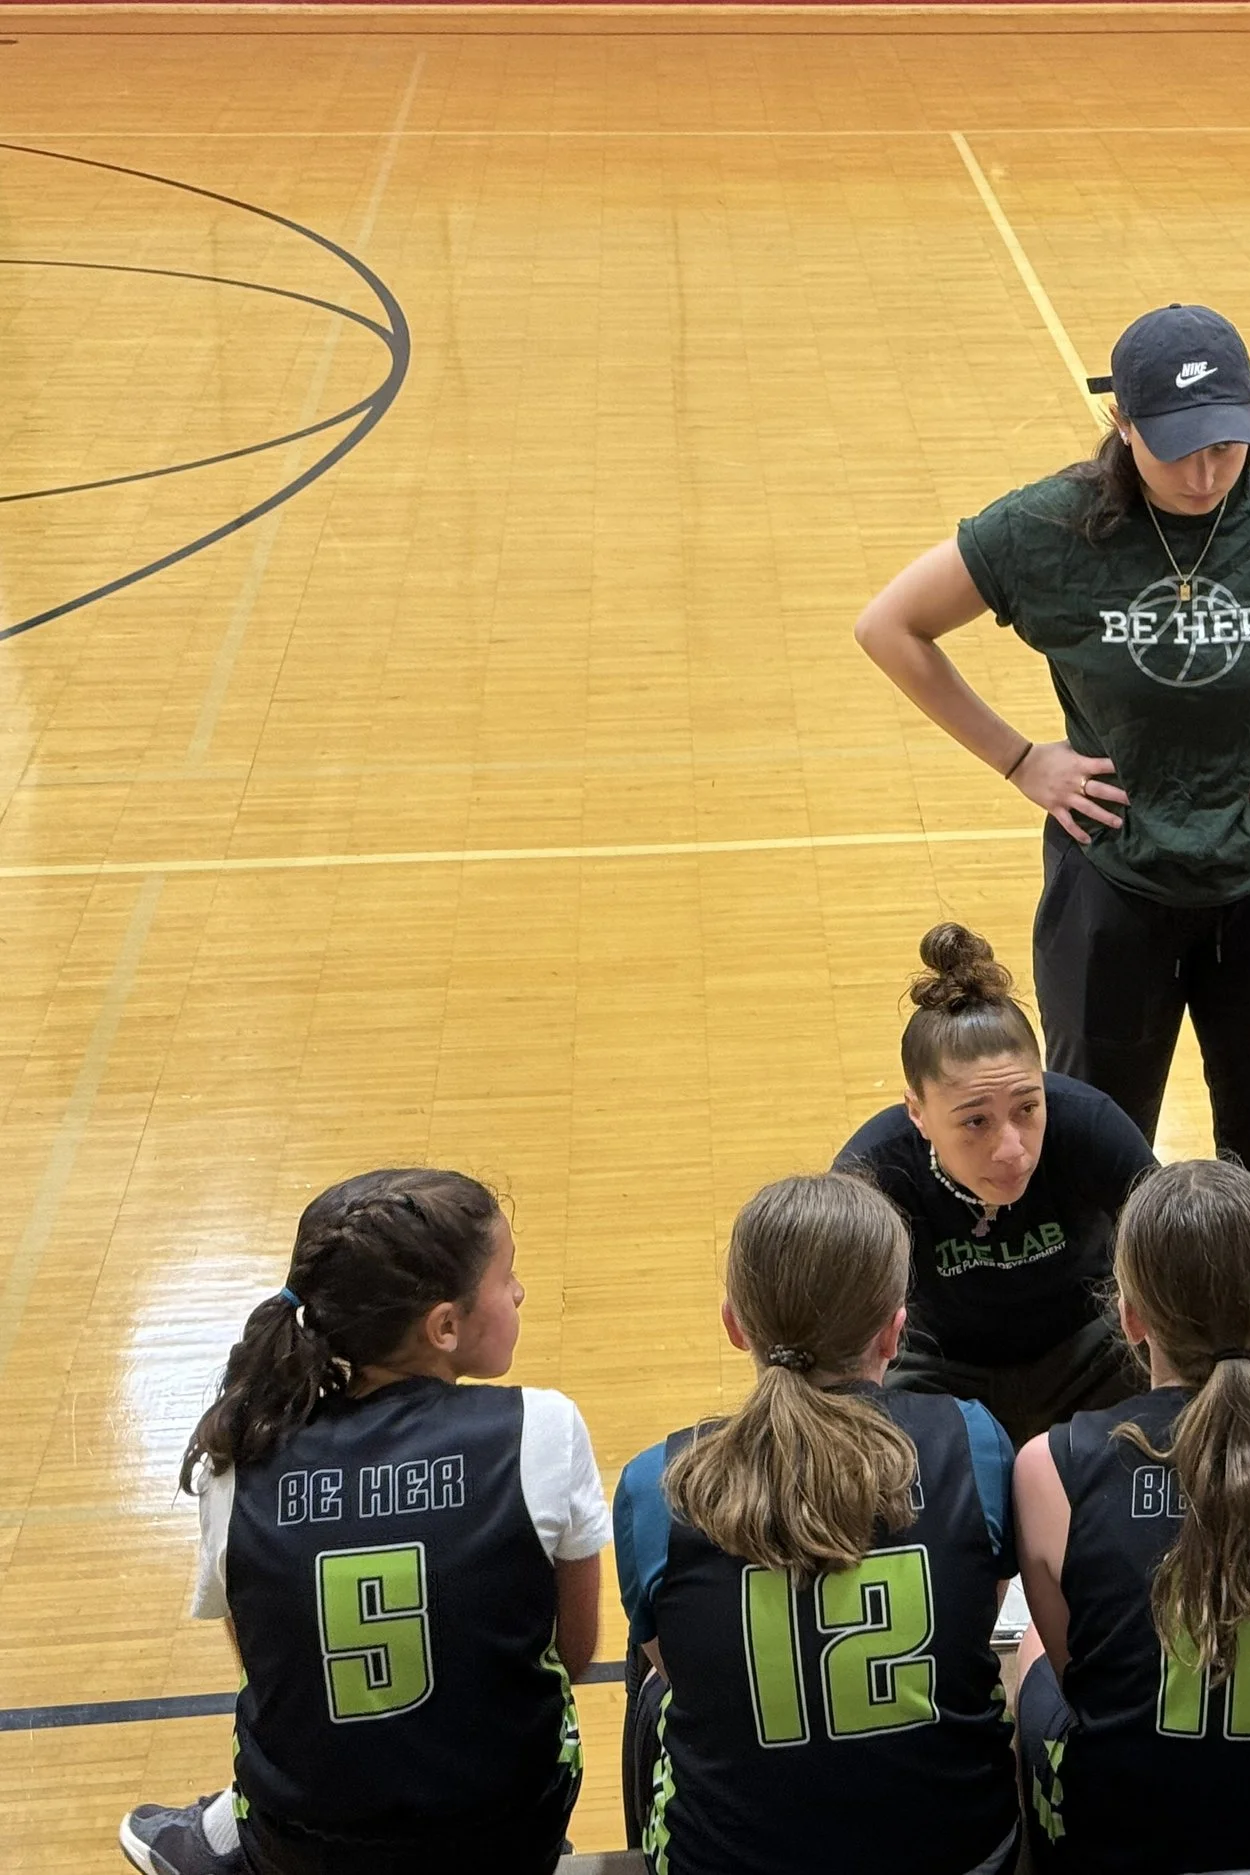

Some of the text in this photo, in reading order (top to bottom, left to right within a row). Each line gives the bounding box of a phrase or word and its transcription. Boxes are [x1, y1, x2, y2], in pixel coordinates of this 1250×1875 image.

[1181, 361, 1208, 377] NIKE
[1099, 610, 1158, 644] BE
[935, 1222, 1064, 1268] THE LAB
[997, 1240, 1067, 1270] DEVELOPMENT
[277, 1454, 465, 1526] BE HER
[315, 1541, 435, 1724] 5
[742, 1544, 940, 1748] 12
